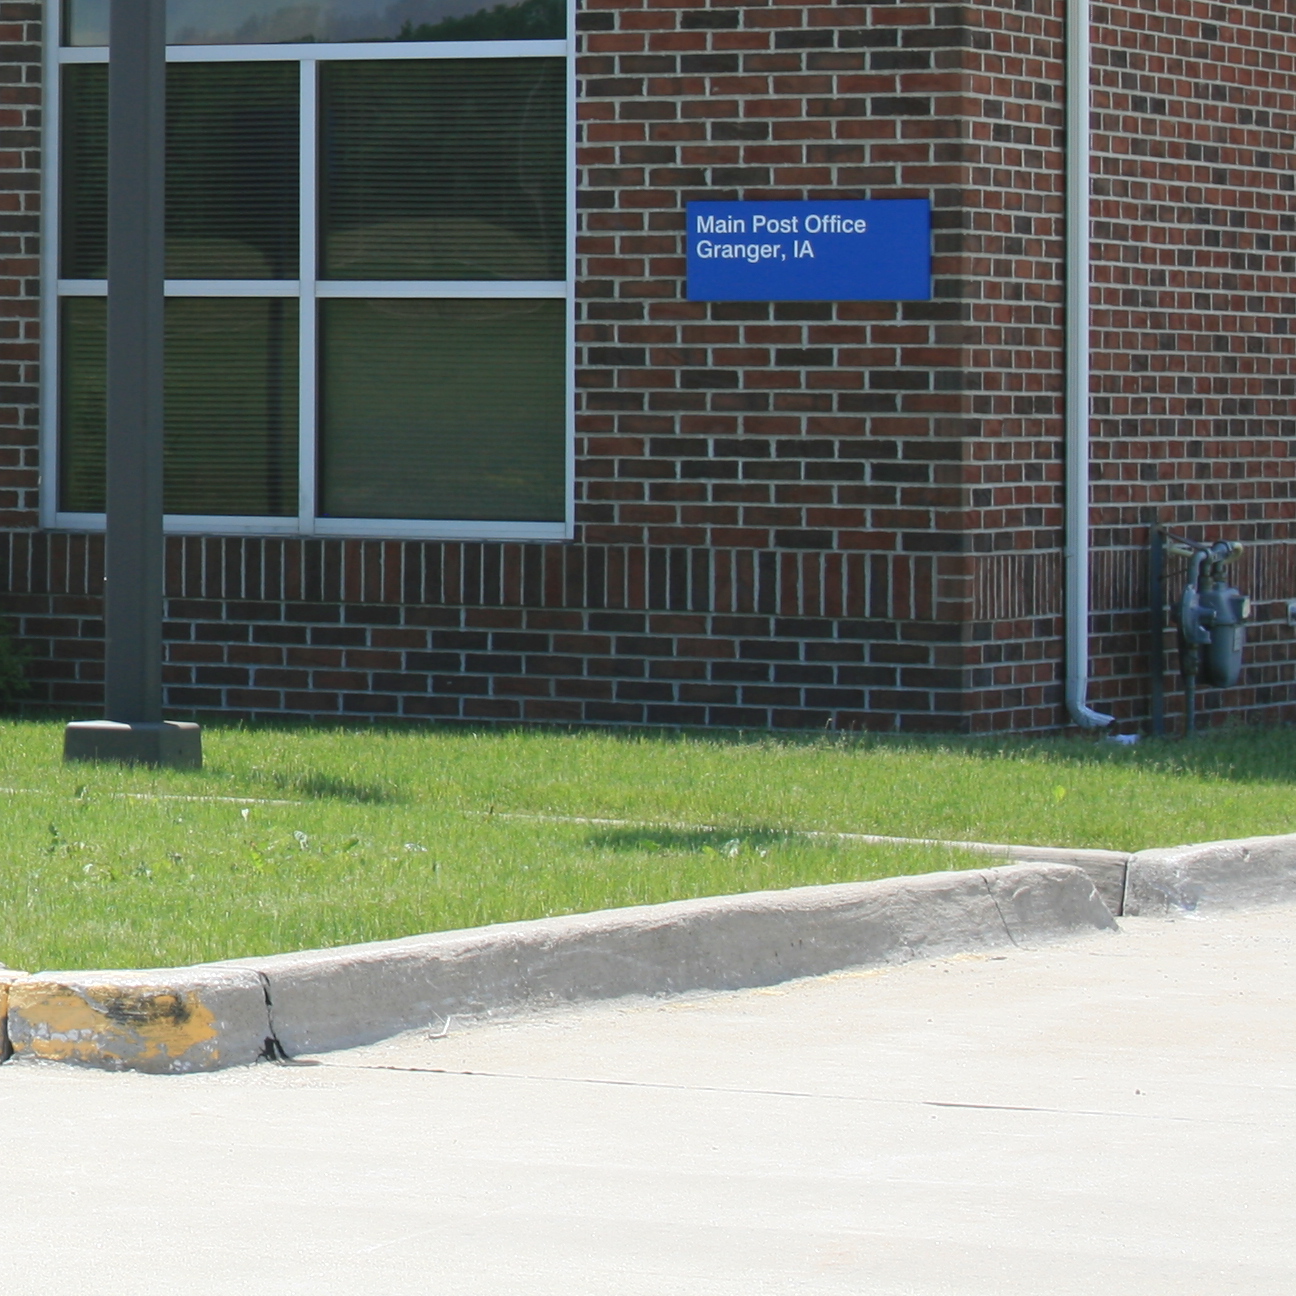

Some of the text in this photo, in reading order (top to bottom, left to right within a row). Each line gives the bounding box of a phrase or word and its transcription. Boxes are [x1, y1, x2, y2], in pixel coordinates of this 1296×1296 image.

[696, 214, 867, 234] Main Post Office
[696, 240, 815, 263] Granger, IA
